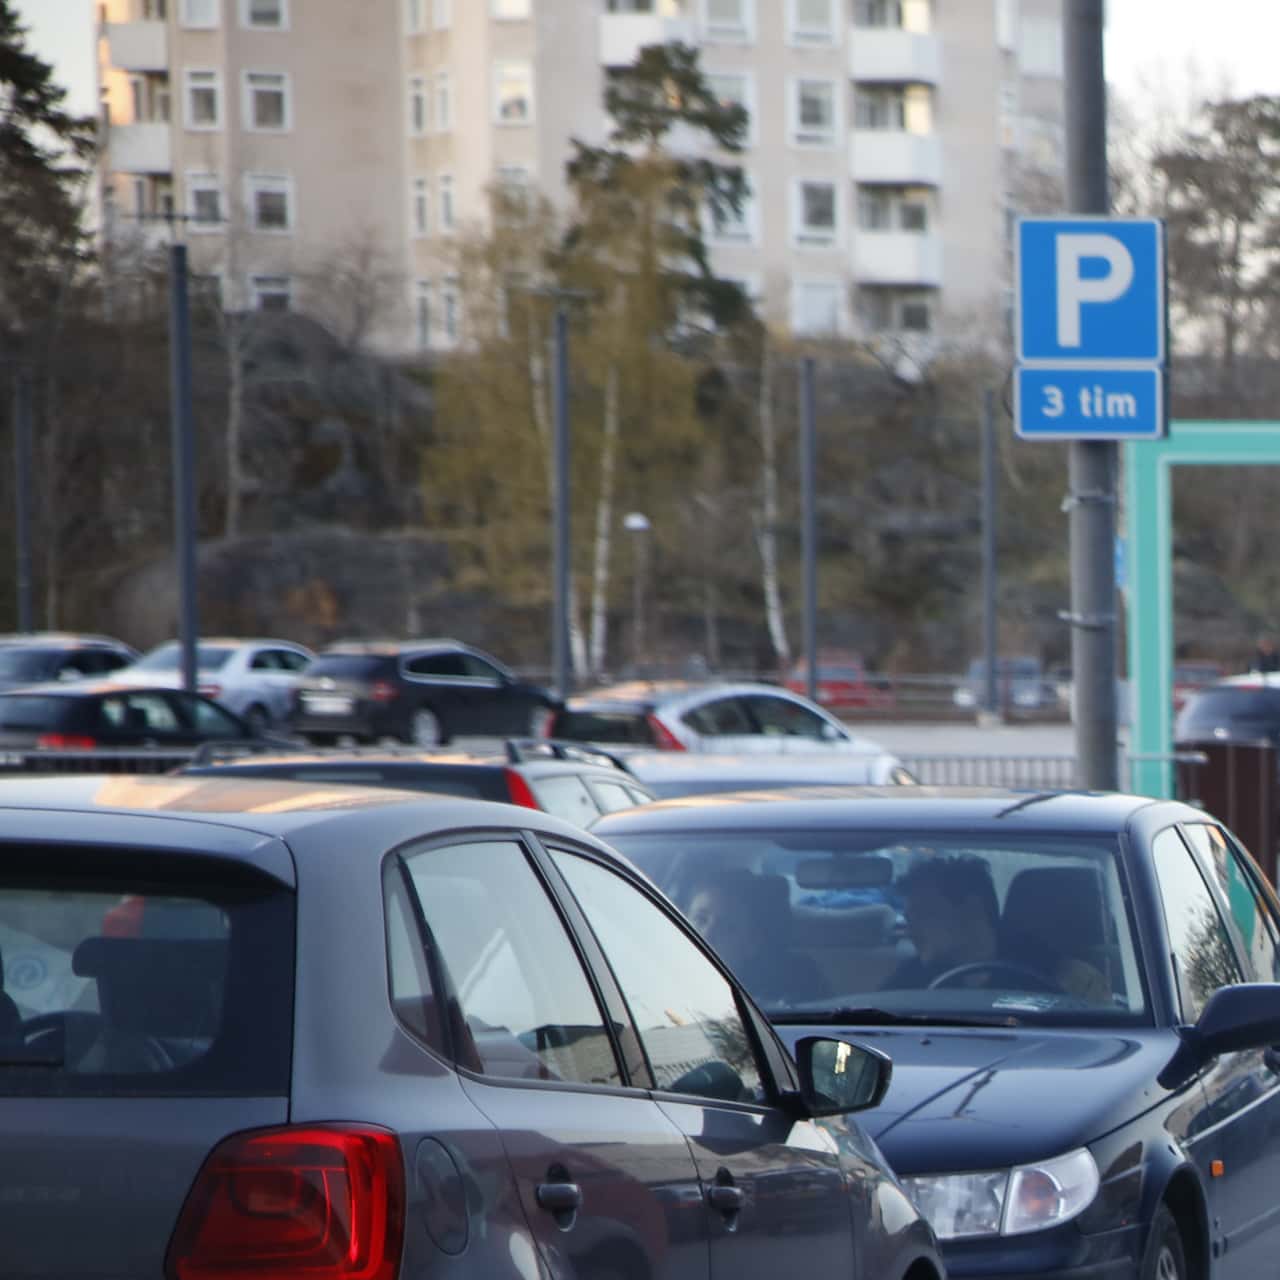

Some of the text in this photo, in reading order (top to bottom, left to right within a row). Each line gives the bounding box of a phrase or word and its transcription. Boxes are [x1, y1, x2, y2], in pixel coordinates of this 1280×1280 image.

[1056, 233, 1134, 348] P
[1042, 385, 1137, 418] 3 tim
